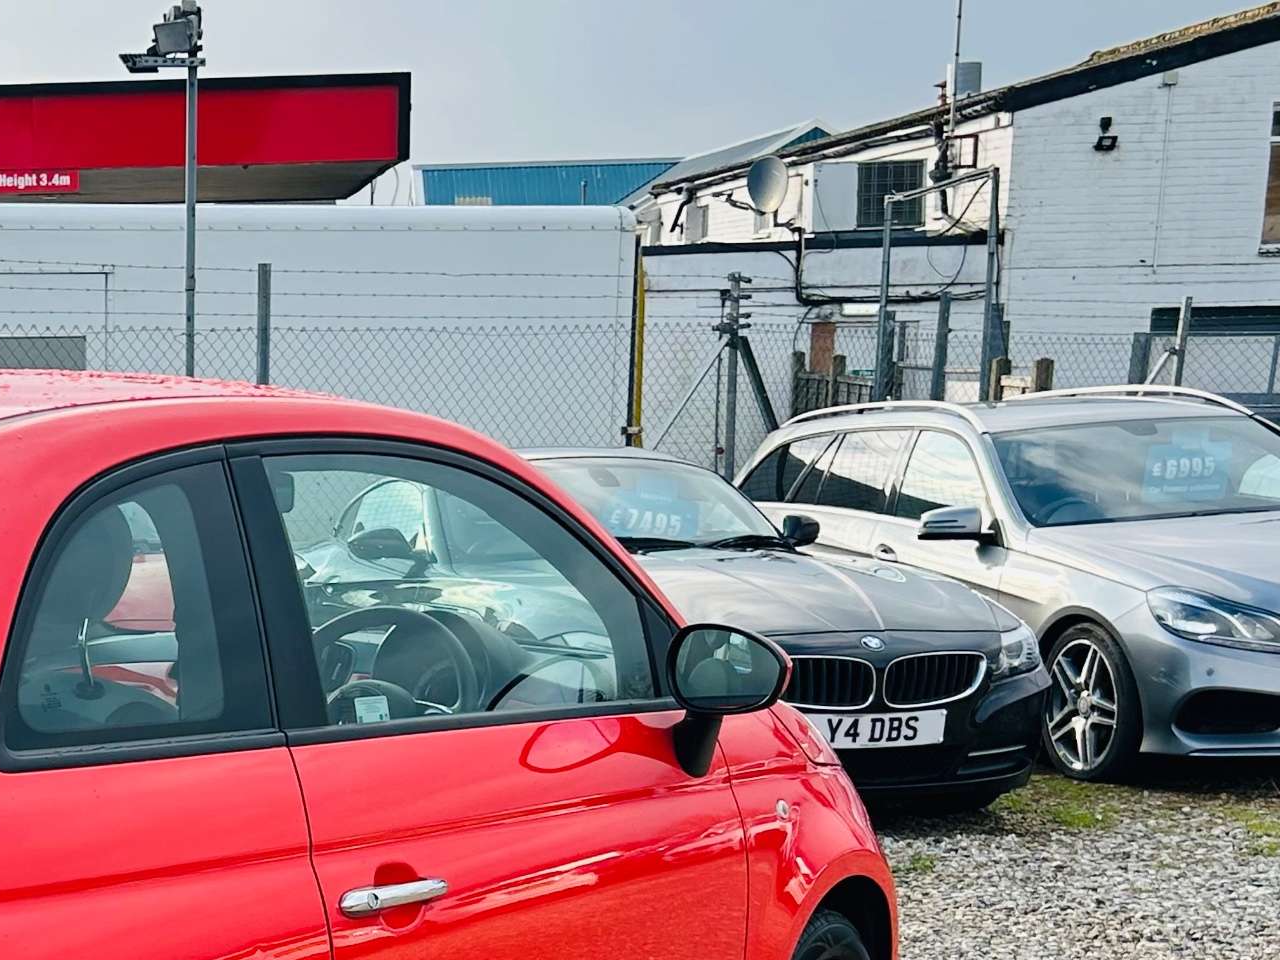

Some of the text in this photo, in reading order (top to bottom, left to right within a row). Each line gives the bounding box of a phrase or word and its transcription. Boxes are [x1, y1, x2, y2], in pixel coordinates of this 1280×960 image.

[39, 173, 70, 187] 3.4m
[827, 716, 920, 743] Y4 DBS
